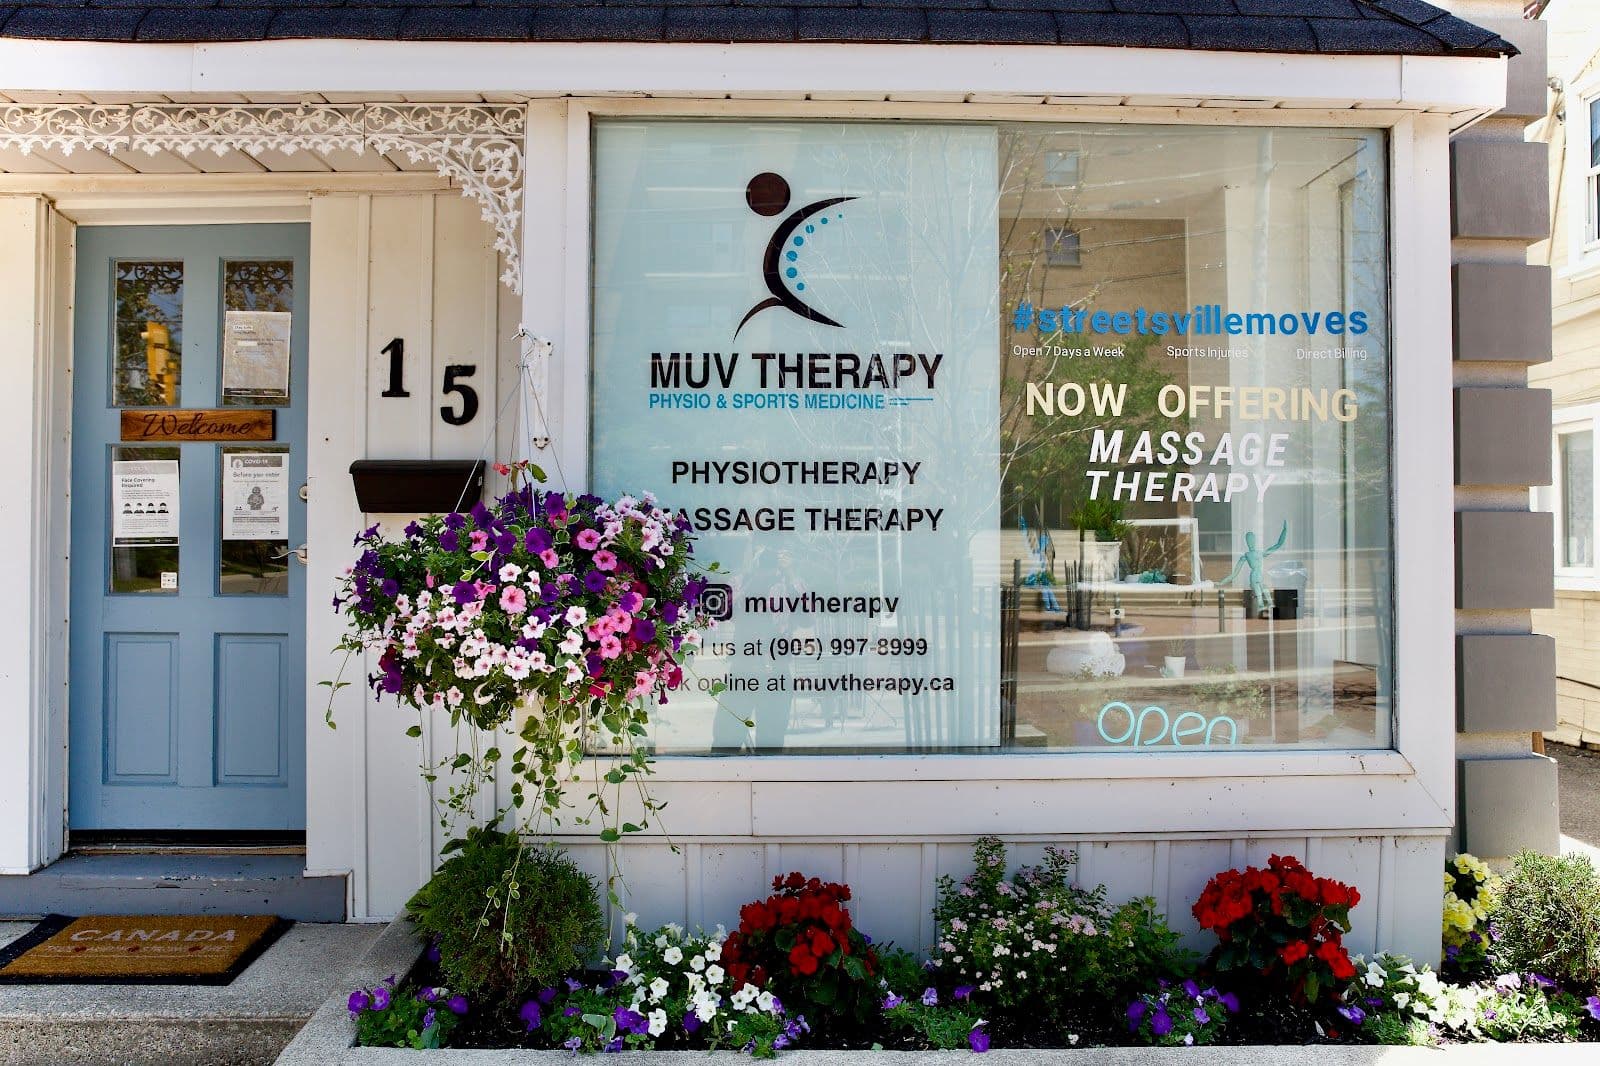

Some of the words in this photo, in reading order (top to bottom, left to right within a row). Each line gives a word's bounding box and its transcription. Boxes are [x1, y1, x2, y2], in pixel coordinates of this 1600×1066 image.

[1011, 302, 1369, 336] #streetsvillemoves
[1013, 345, 1042, 358] Open
[1044, 346, 1051, 356] 7
[1053, 346, 1082, 359] Days
[1084, 348, 1091, 357] a
[1093, 346, 1125, 357] Week
[1166, 345, 1205, 359] Sports
[1207, 347, 1248, 359] Injuries
[1296, 348, 1332, 360] Direct
[1334, 348, 1367, 360] Billing
[650, 353, 739, 389] MUV
[751, 353, 944, 389] THERAPY
[649, 393, 712, 409] PHYSIO
[716, 394, 727, 408] &
[733, 393, 799, 409] SPORTS
[804, 394, 885, 409] MEDICINE
[1026, 382, 1127, 417] NOW
[1157, 384, 1359, 423] OFFERING
[143, 412, 251, 436] Welcome
[1088, 429, 1289, 467] MASSAGE
[672, 461, 922, 485] PHYSIOTHERAPY
[1086, 470, 1275, 503] THERAPY
[805, 508, 944, 532] THERAPY
[712, 642, 736, 656] us
[743, 639, 763, 656] at
[770, 638, 823, 661] (905)
[830, 638, 928, 656] 997-8999
[767, 674, 786, 692] at
[793, 673, 955, 696] muvtherapy.ca
[70, 929, 236, 942] CANADA
